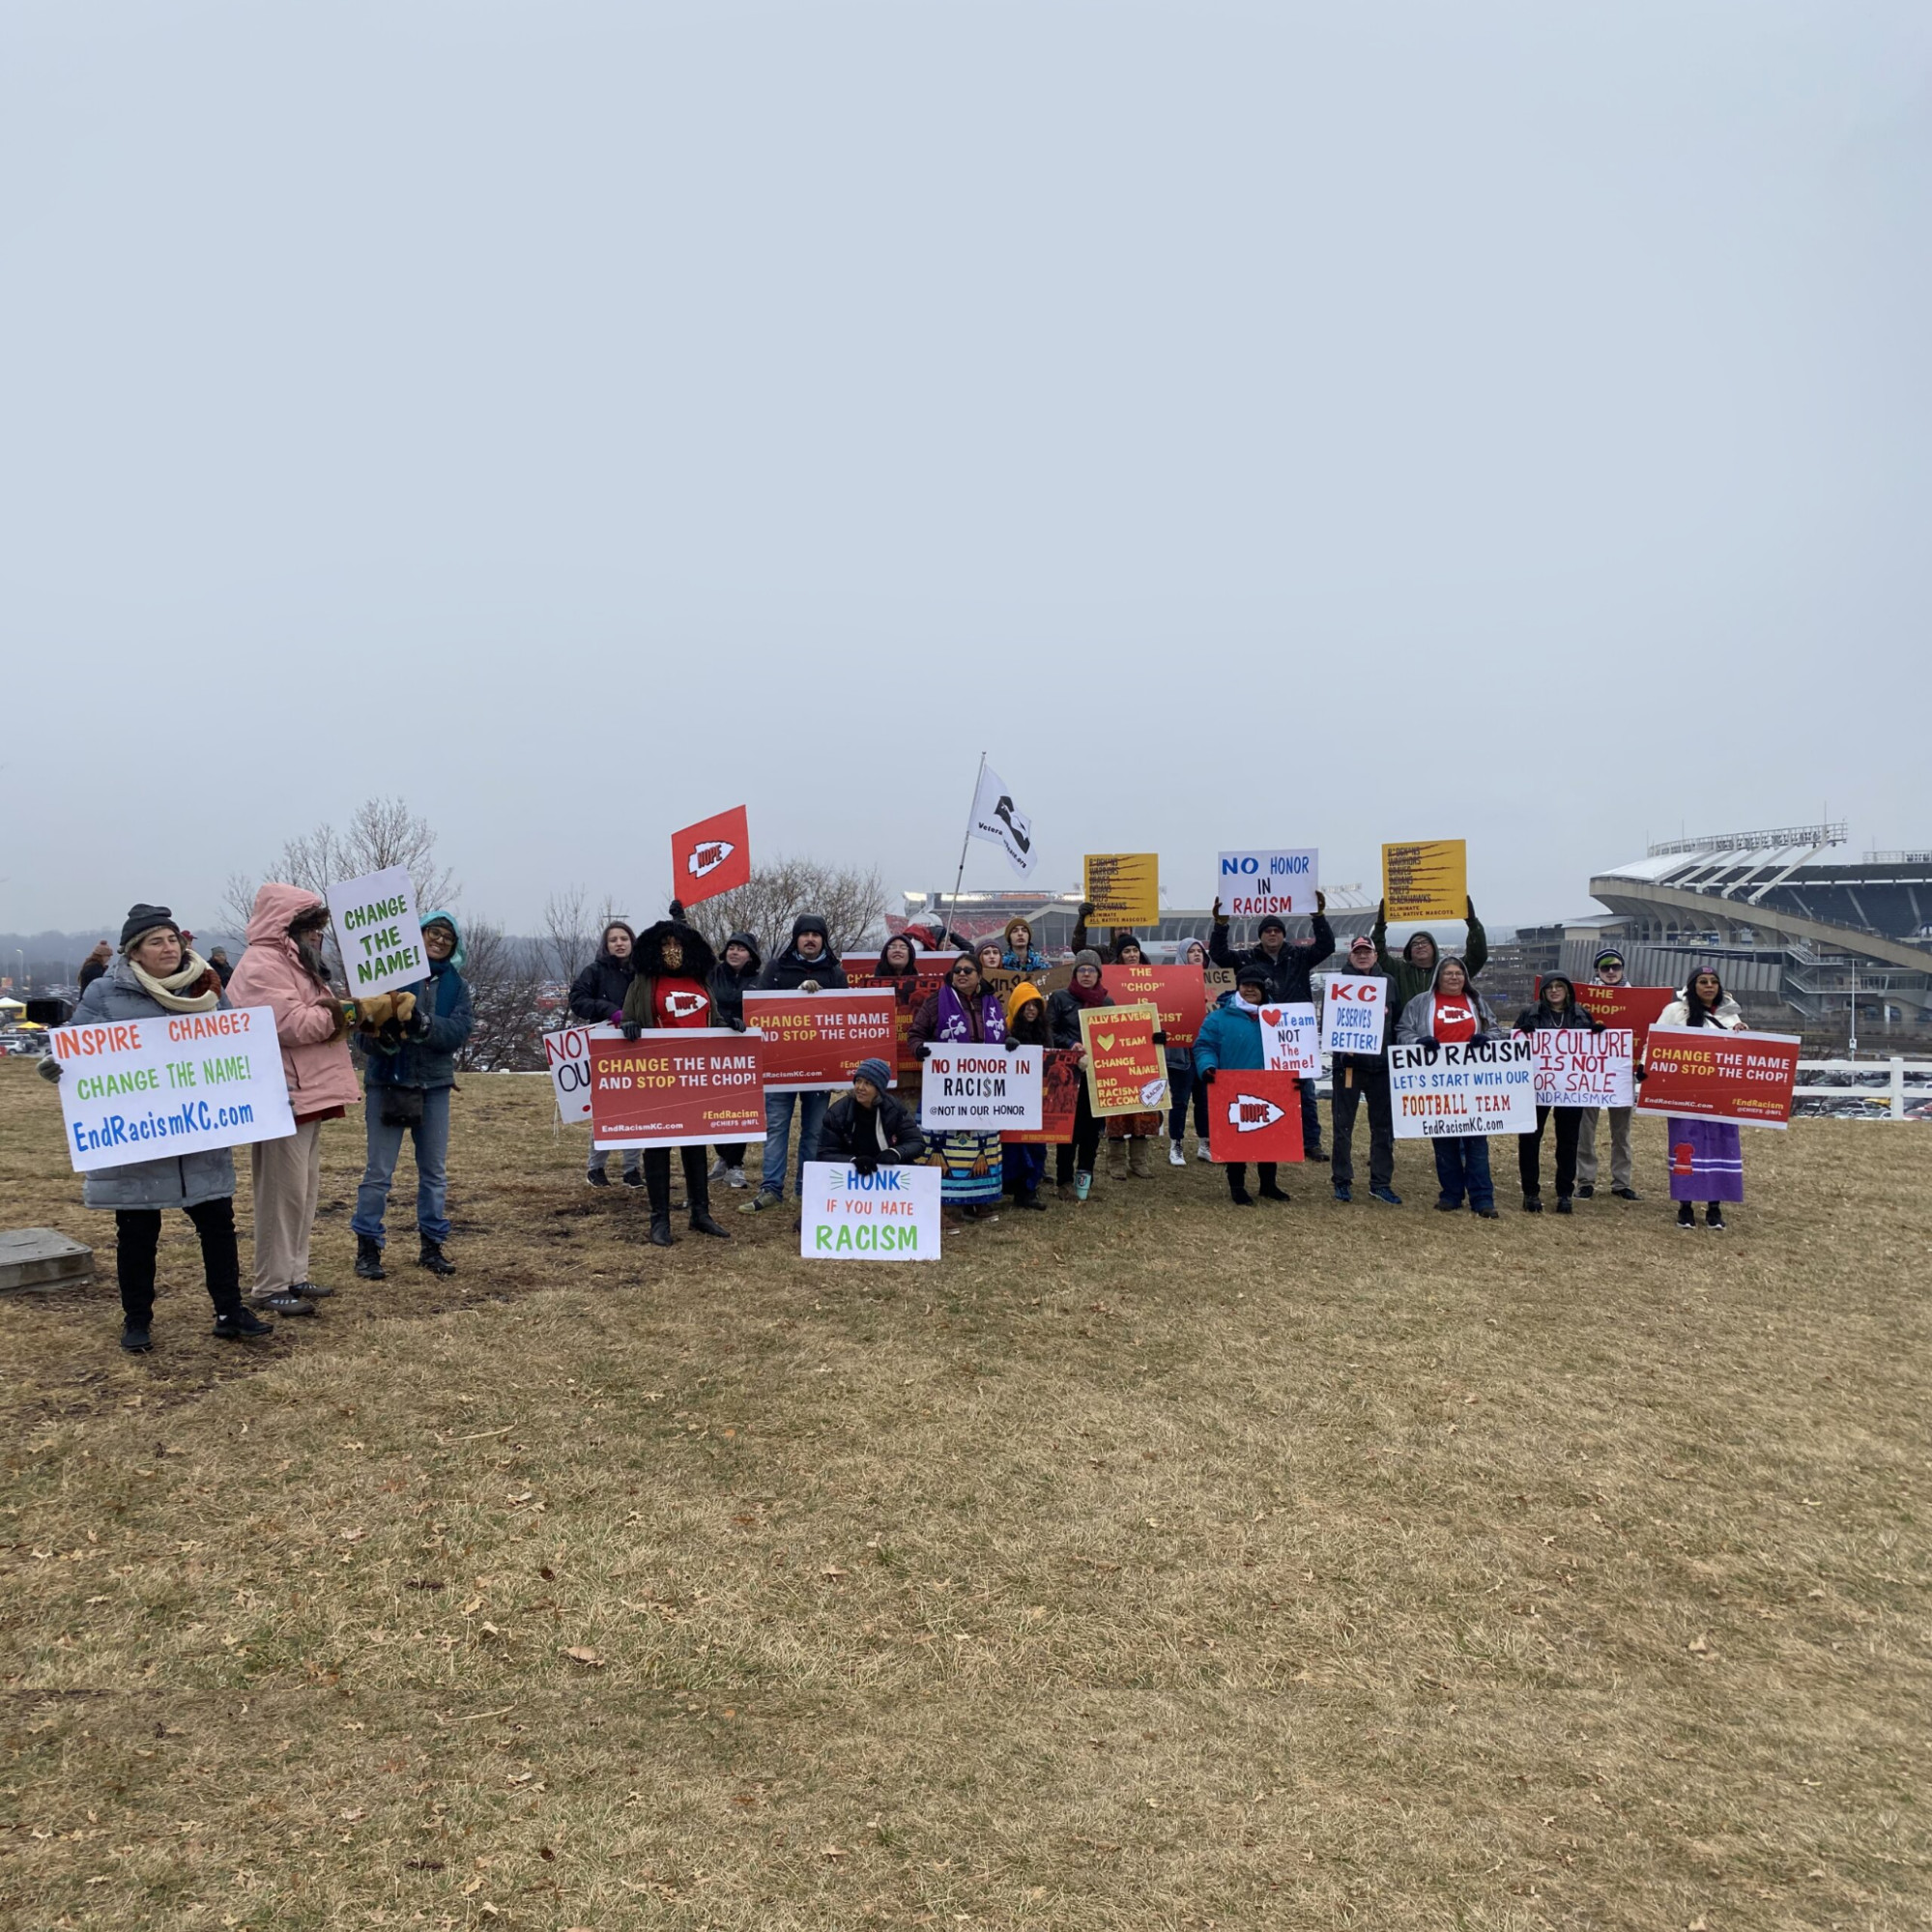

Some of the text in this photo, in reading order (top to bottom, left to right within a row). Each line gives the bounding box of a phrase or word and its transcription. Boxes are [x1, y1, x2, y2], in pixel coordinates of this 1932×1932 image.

[978, 822, 1003, 836] Vetera
[697, 845, 723, 869] NOPE
[1222, 855, 1310, 876] NO HONOR
[1257, 877, 1271, 895] IN
[344, 894, 408, 931] CHANGE
[1233, 895, 1292, 914] RACISM
[360, 926, 402, 956] THE
[358, 945, 420, 984] NAME!
[1129, 967, 1152, 977] THE
[1204, 970, 1231, 984] NGE
[1121, 982, 1165, 992] "CHOP"
[1587, 988, 1614, 999] THE
[674, 995, 699, 1010] NOPE
[749, 1013, 889, 1027] CHANGE THE NAME
[1088, 1012, 1151, 1024] ALLY IS A VERB
[1159, 1013, 1183, 1023] CIST
[1282, 1012, 1315, 1026] Team
[1337, 1006, 1371, 1029] DESERVES
[1444, 1009, 1466, 1019] NOPE
[55, 1012, 250, 1059] INSPIRE CHANGE?
[761, 1031, 779, 1042] ND
[783, 1029, 818, 1041] STOP
[820, 1028, 846, 1040] THE
[849, 1027, 890, 1039] CHOP!
[1119, 1036, 1147, 1047] TEAM
[1278, 1029, 1301, 1043] NOT
[1331, 1031, 1378, 1051] BETTER!
[1555, 1028, 1632, 1058] CULTURE
[545, 1026, 595, 1066] NOT
[1281, 1044, 1300, 1056] The
[1392, 1040, 1532, 1070] END RACISM
[598, 1055, 756, 1074] CHANGE THE NAME
[931, 1058, 950, 1075] NO
[957, 1058, 1007, 1074] HONOR
[1016, 1059, 1030, 1075] IN
[1094, 1056, 1136, 1069] CHANGE
[1270, 1054, 1314, 1070] Name!
[1540, 1055, 1608, 1074] IS NOT
[1652, 1048, 1712, 1063] CHANGE
[1715, 1053, 1743, 1065] THE
[1746, 1055, 1790, 1070] NAME
[77, 1055, 251, 1100] CHANGE THE NAME!
[559, 1059, 591, 1092] OU
[1129, 1065, 1159, 1076] NAME!
[1393, 1070, 1530, 1089] LET'S START WITH OUR
[1650, 1061, 1678, 1073] AND
[1681, 1064, 1716, 1076] STOP
[1717, 1067, 1743, 1079] THE
[1745, 1069, 1788, 1083] CHOP!
[598, 1072, 757, 1090] AND STOP THE CHOP!
[1096, 1078, 1117, 1088] END
[1534, 1073, 1616, 1093] OR SALE
[1098, 1086, 1139, 1098] RACISM
[1145, 1082, 1165, 1100] RACIST
[1536, 1091, 1618, 1105] NDRACISMKC
[930, 1105, 1024, 1116] @NOT IN OUR HONOR
[1099, 1095, 1140, 1108] KC.COM
[1402, 1093, 1511, 1116] FOOTBALL TEAM
[1644, 1097, 1784, 1110] EndRacismKC.com #EndRacism
[601, 1110, 759, 1133] EndRacismKC.com #EndRacism
[1239, 1104, 1270, 1123] NOPE
[72, 1101, 254, 1152] EndRacismKC.com
[1423, 1116, 1504, 1136] EndRacismKC.com
[847, 1169, 901, 1191] HONK
[826, 1198, 914, 1216] IF YOU HATE
[816, 1225, 918, 1253] RACISM
